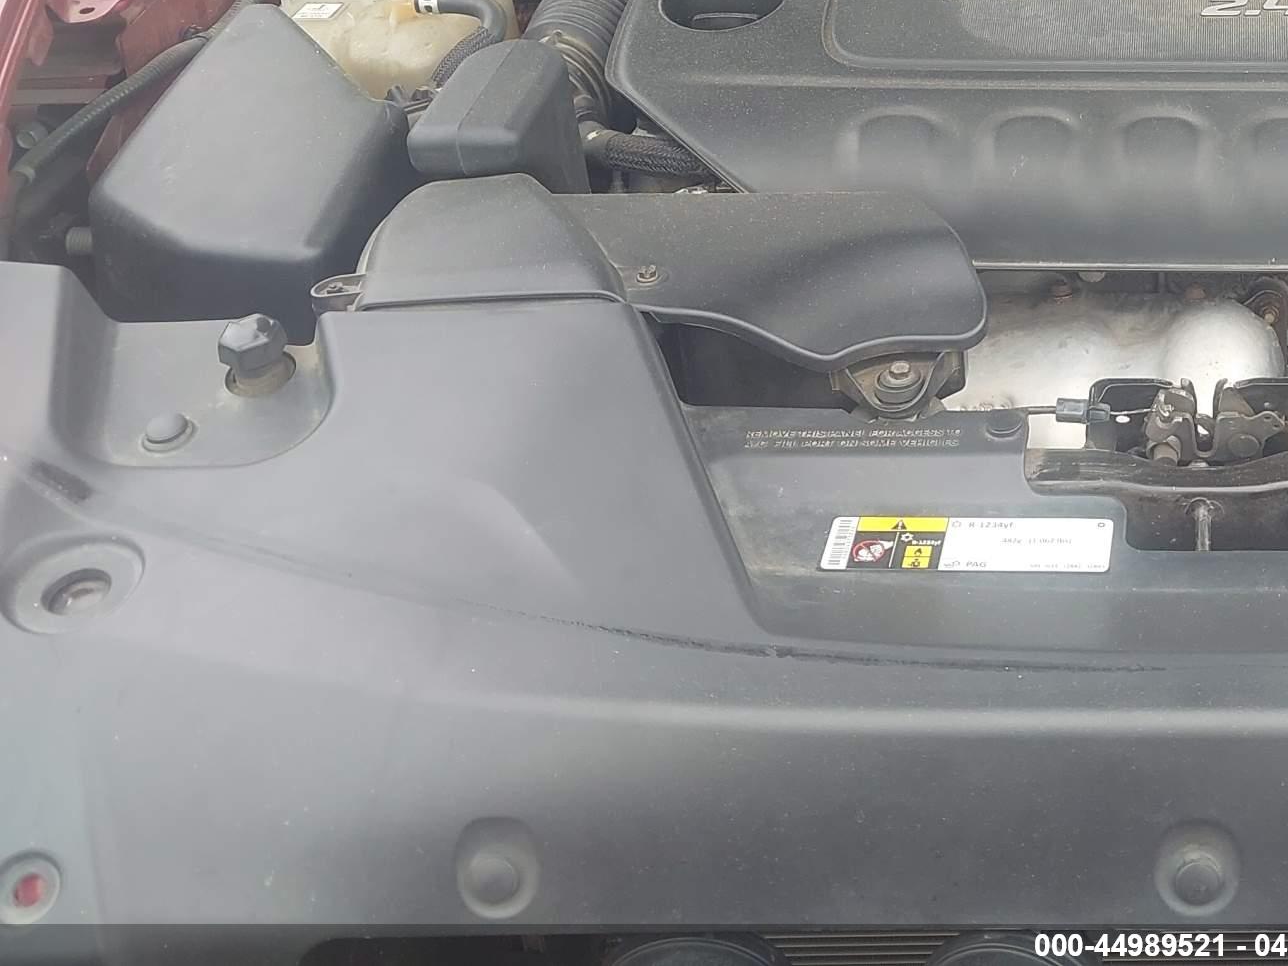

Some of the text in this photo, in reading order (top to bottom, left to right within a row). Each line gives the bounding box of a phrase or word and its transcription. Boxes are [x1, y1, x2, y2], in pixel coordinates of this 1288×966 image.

[746, 429, 961, 438] REMOVE THIS PANEL FOR ACCESS TO
[774, 440, 799, 448] FILL
[801, 440, 834, 448] PORT
[839, 440, 859, 448] ON
[860, 439, 897, 447] SOME
[899, 439, 961, 447] VEHICLES
